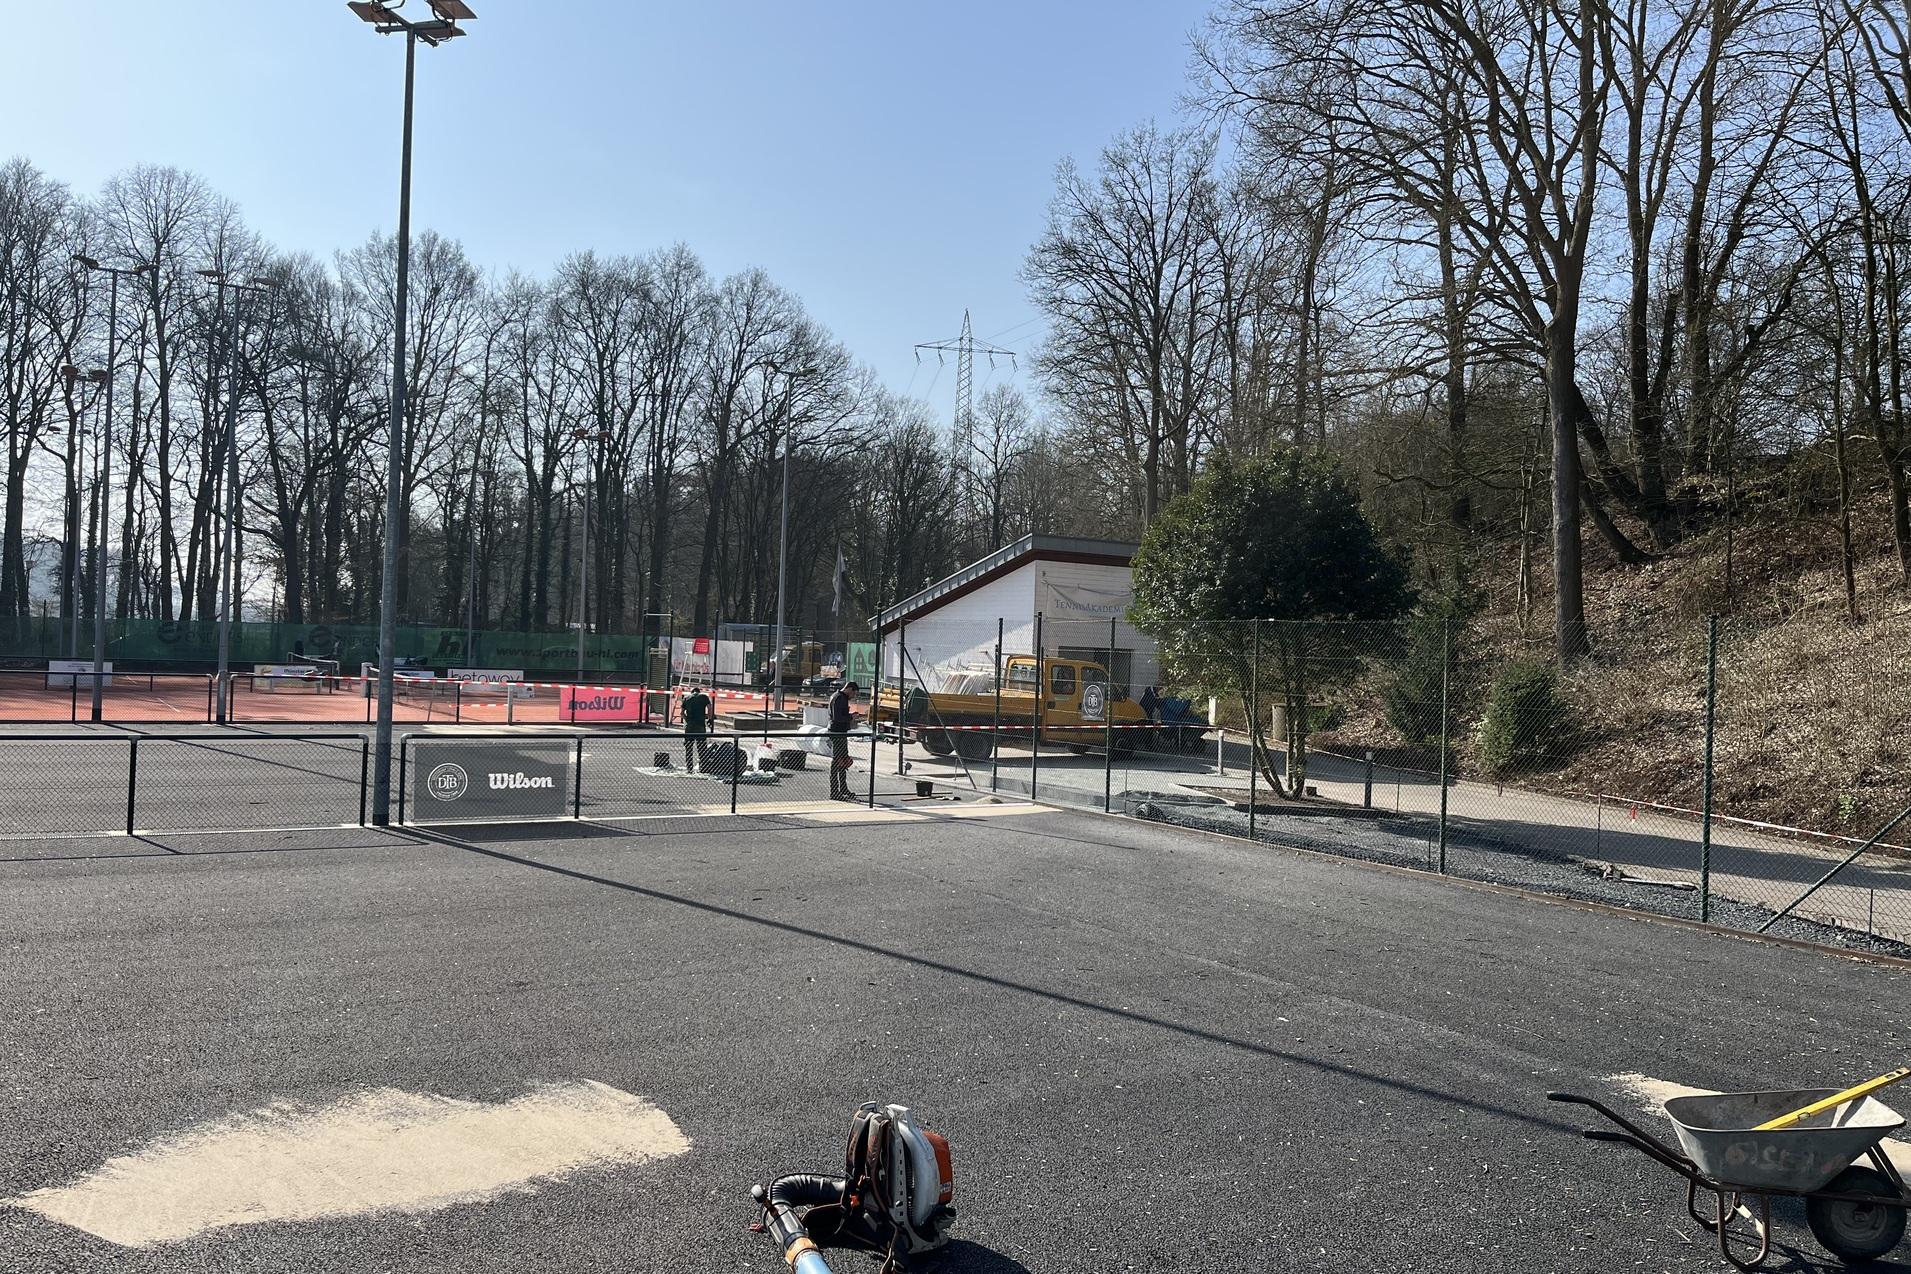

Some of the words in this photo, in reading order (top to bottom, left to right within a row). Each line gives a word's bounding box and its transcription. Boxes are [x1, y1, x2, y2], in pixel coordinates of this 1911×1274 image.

[496, 647, 640, 660] www.sportbu-hl.com
[438, 774, 457, 789] DTB
[488, 772, 555, 789] Wilson
